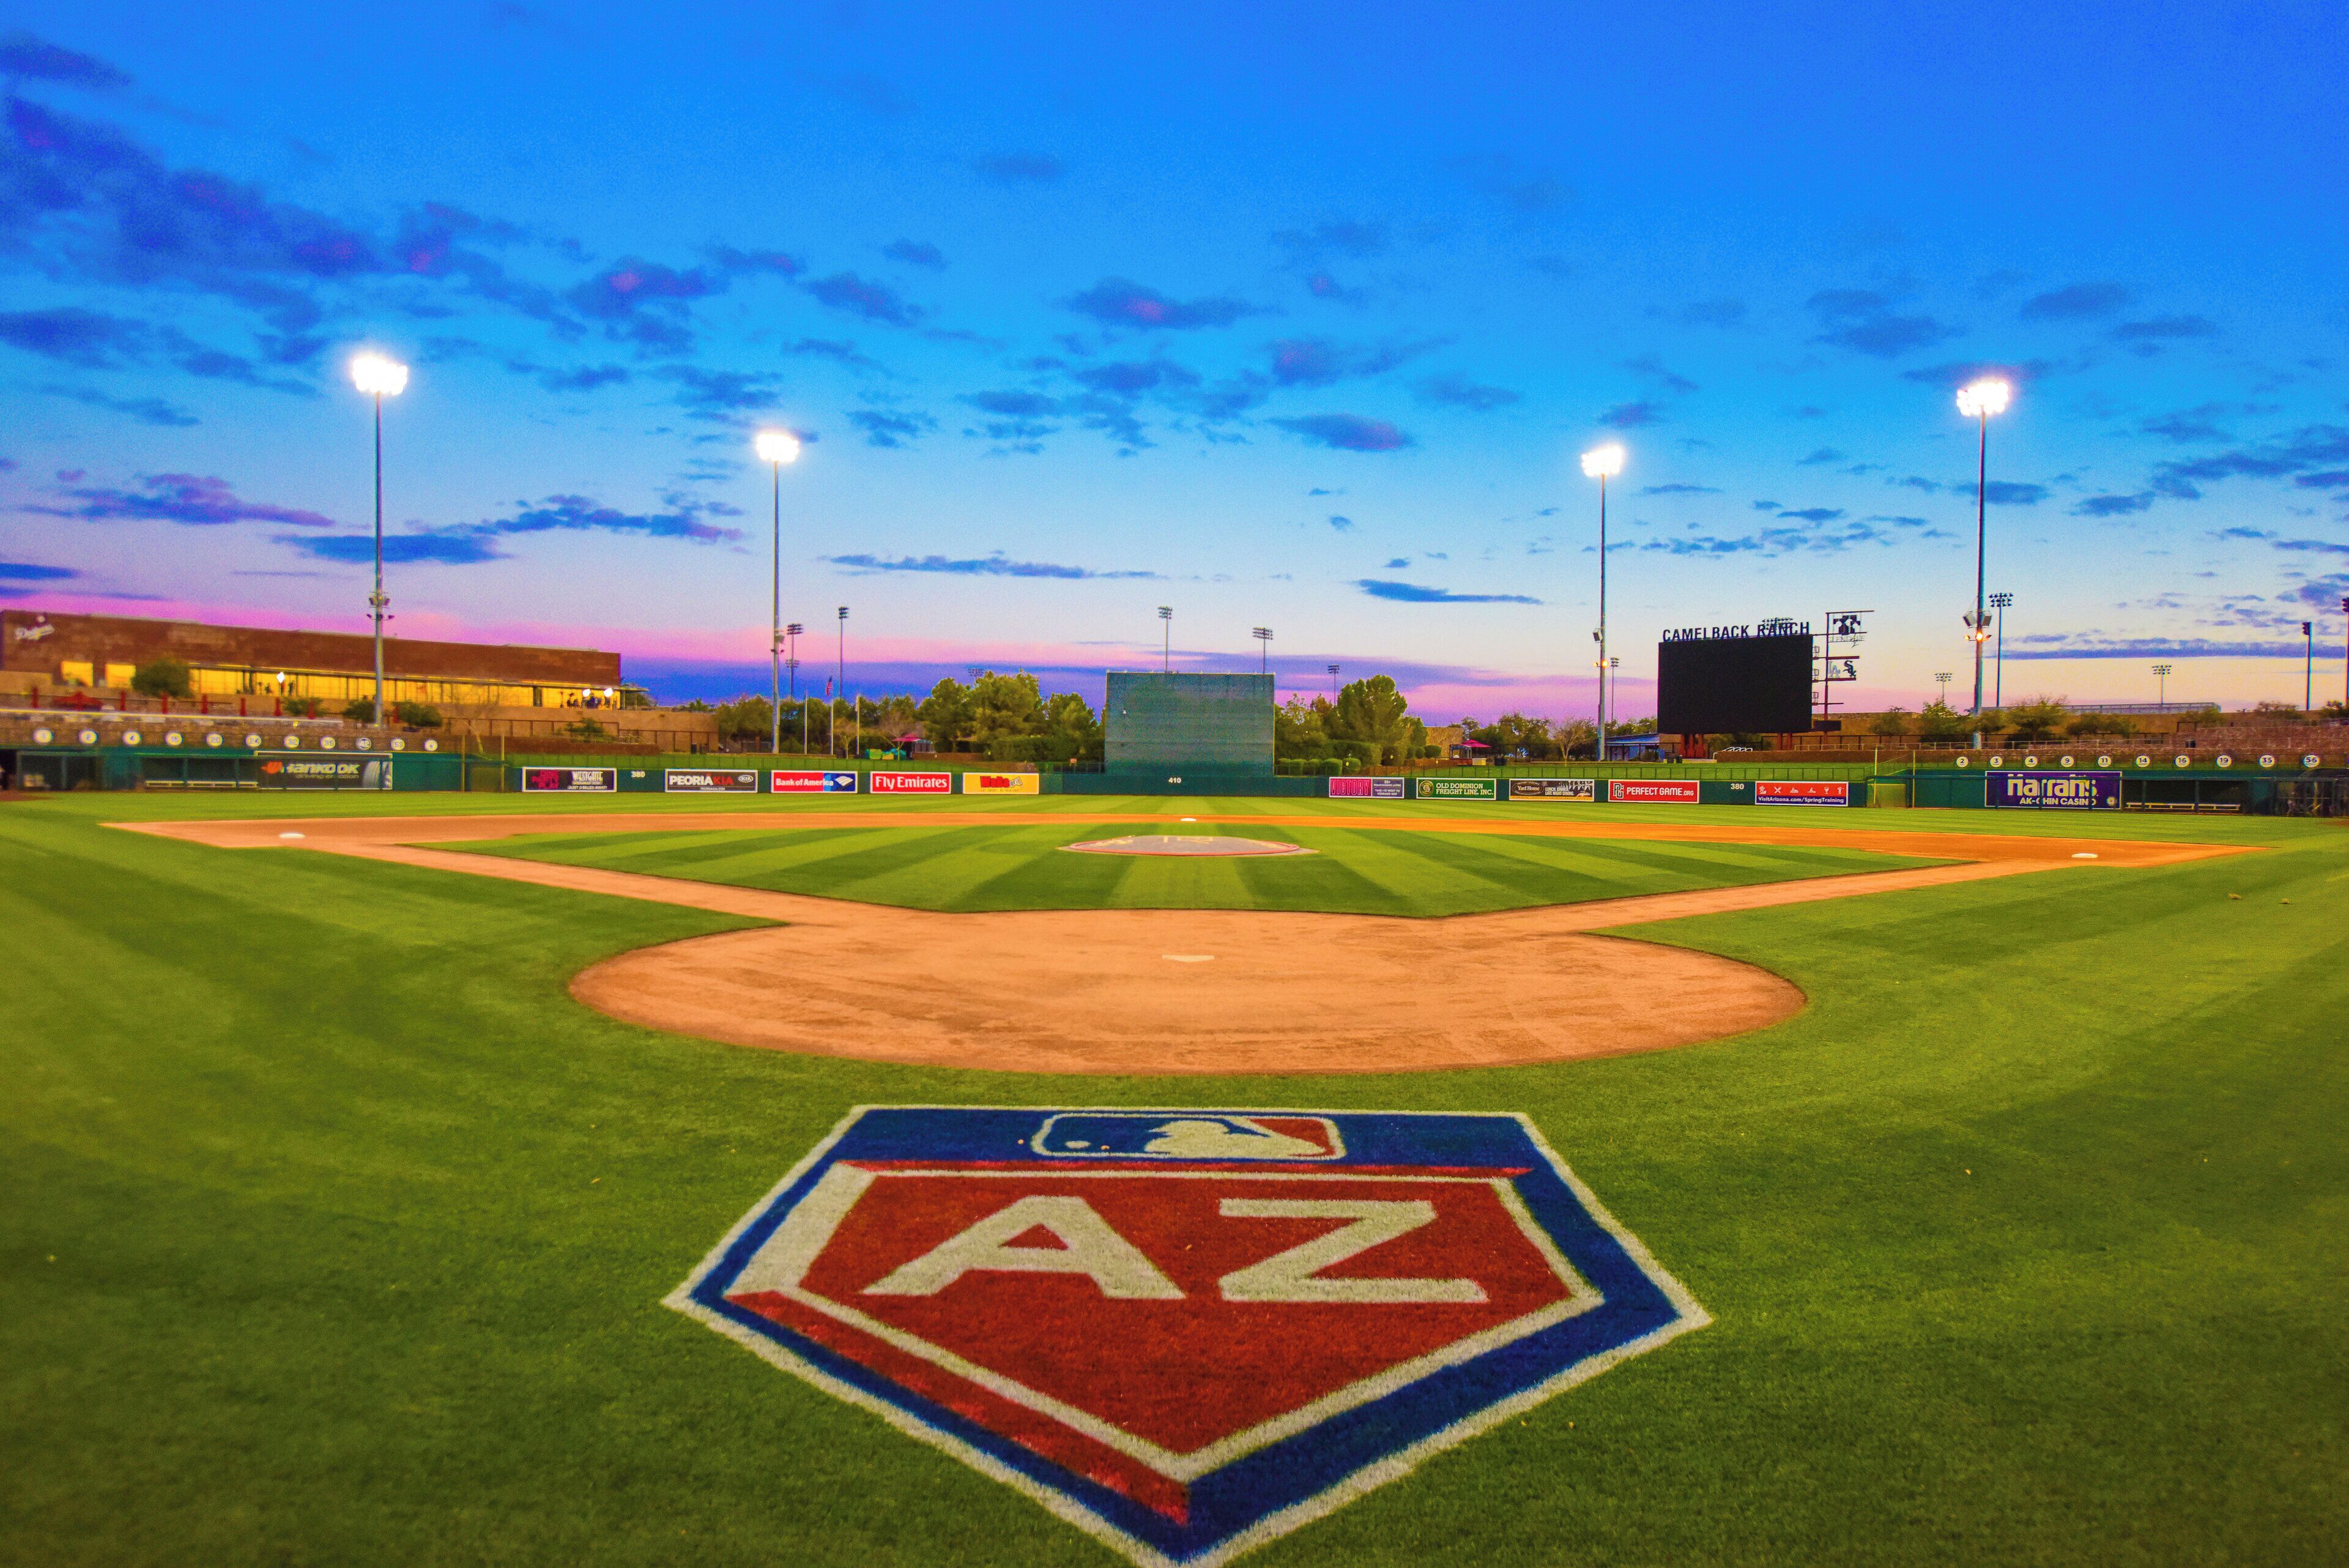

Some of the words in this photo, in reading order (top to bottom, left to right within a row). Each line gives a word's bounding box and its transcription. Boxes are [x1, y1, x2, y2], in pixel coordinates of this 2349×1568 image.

[1663, 625, 1749, 642] CAMELBACK
[1757, 622, 1809, 637] RANCH
[571, 771, 604, 781] WESTGATE
[669, 775, 714, 786] PEORIA
[713, 776, 733, 786] KIA
[804, 778, 834, 787] America
[875, 776, 895, 790] Fly
[897, 777, 947, 789] Emirates
[1330, 779, 1371, 795] VICTORY
[1627, 787, 1658, 795] PERFECT
[861, 1196, 1489, 1302] AZ
